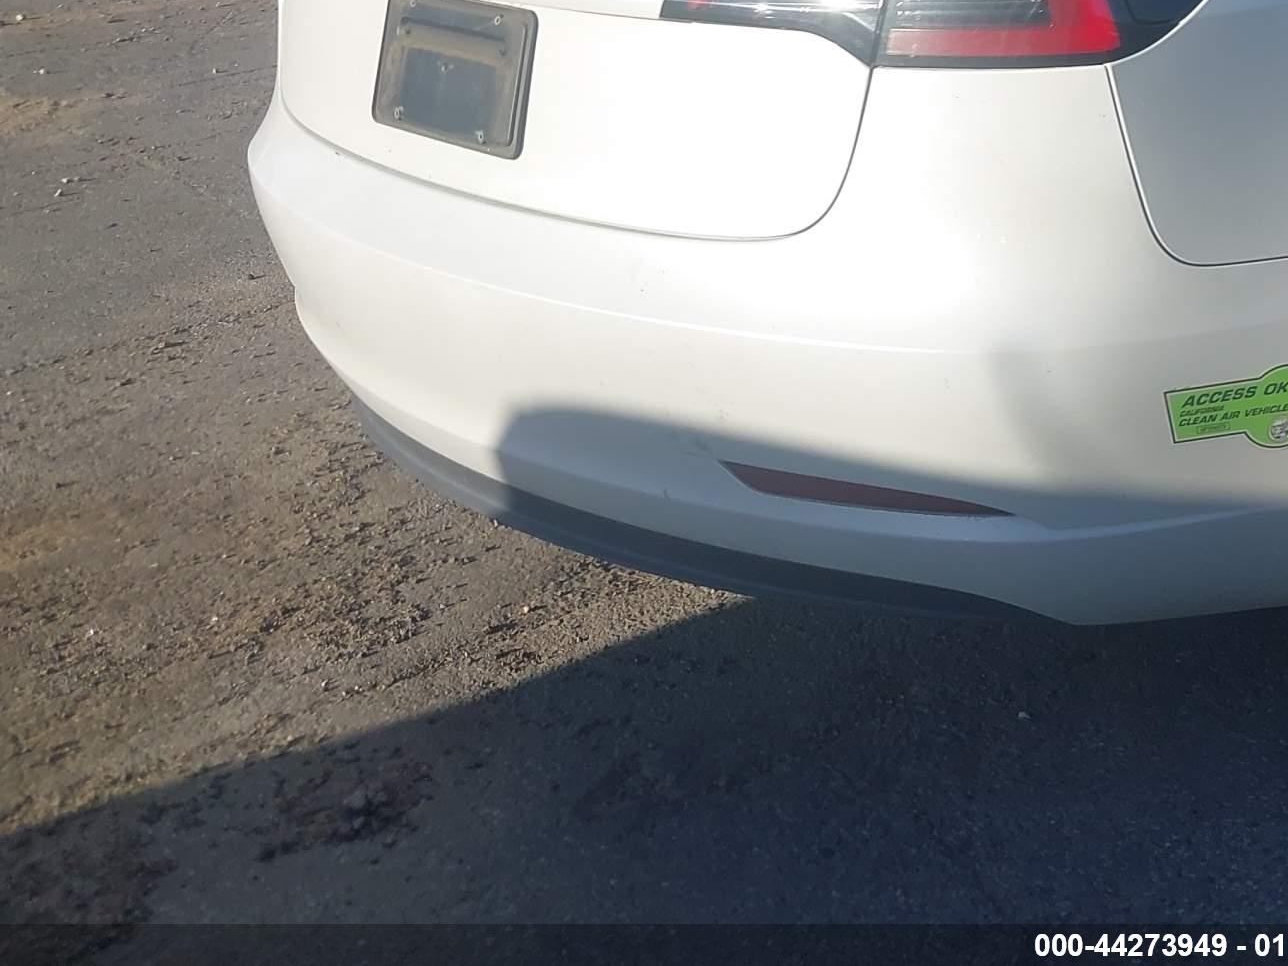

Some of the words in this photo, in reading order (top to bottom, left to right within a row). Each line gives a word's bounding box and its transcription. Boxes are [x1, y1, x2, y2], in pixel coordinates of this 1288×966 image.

[1181, 387, 1257, 408] ACCESS
[1178, 414, 1218, 427] CLEAN
[1220, 411, 1241, 422] AIR
